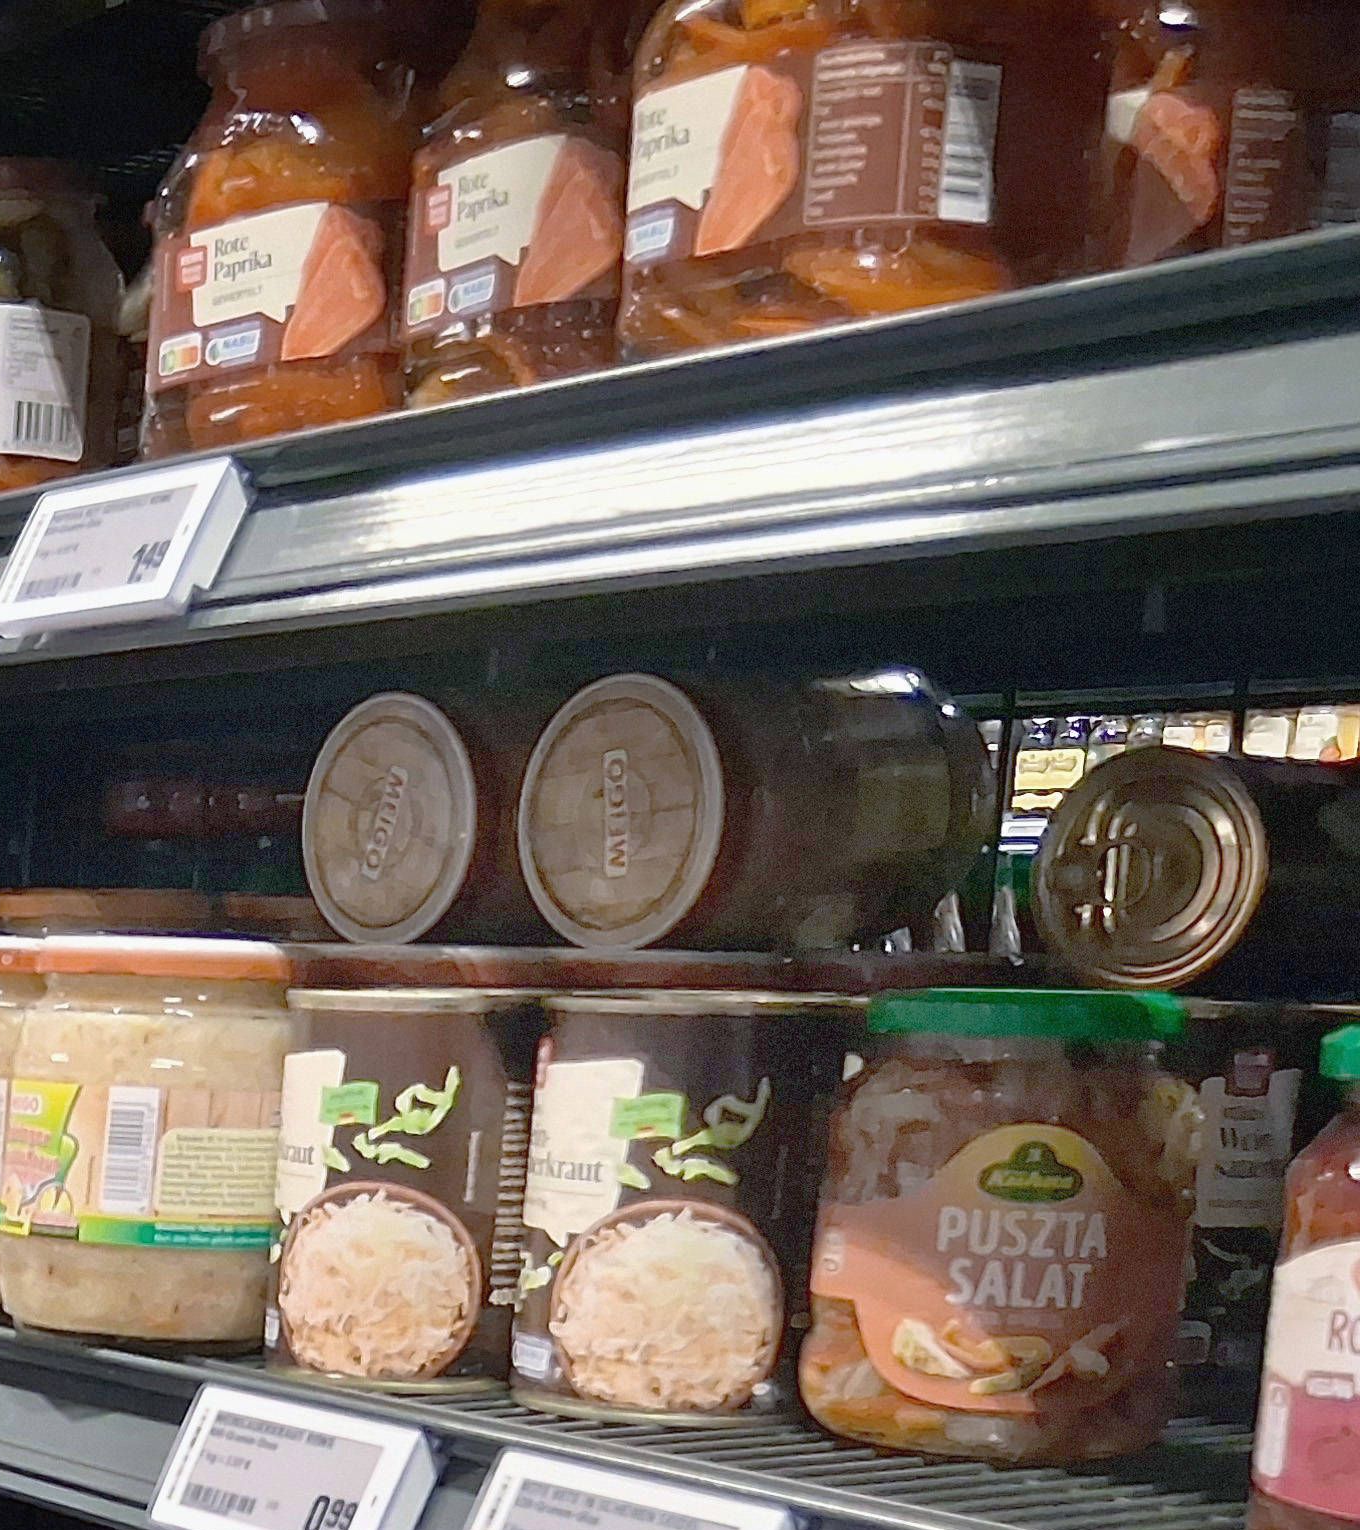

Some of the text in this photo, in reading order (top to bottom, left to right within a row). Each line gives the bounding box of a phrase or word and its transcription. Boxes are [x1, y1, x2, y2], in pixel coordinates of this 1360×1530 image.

[458, 171, 489, 197] Rote
[457, 189, 510, 223] Paprika
[214, 233, 249, 260] Rote
[214, 250, 272, 282] Paprika
[937, 1205, 1108, 1259] PUSZTA
[946, 1256, 1093, 1310] SALAT
